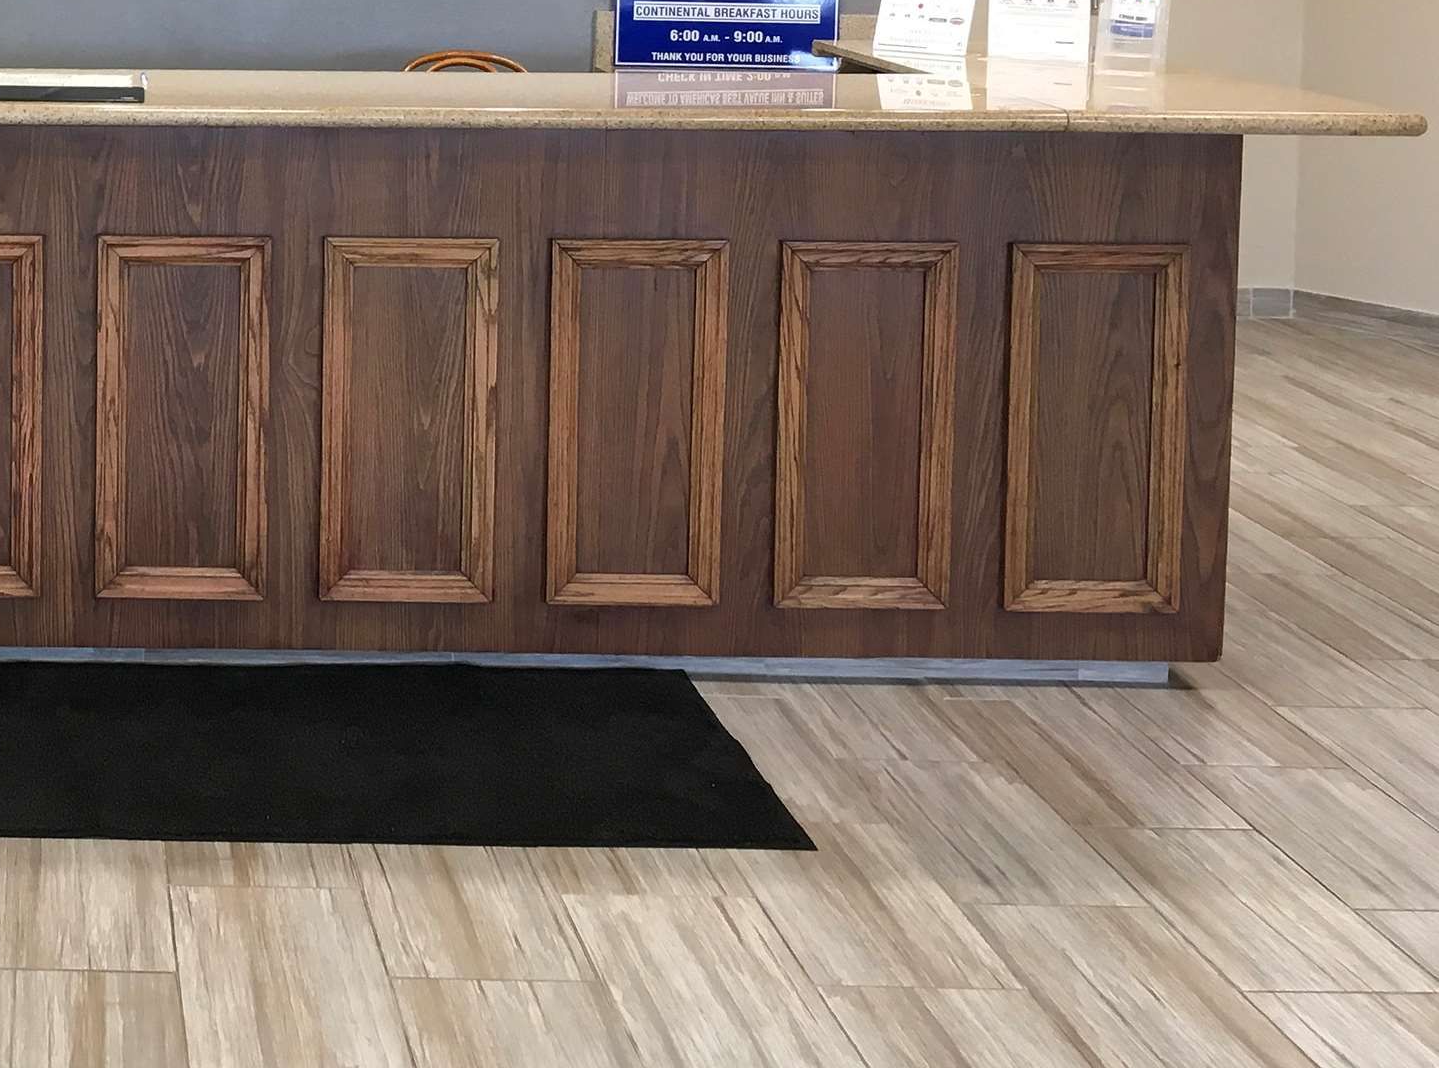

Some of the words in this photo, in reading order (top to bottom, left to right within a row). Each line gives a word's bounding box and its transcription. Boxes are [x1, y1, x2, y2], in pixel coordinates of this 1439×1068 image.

[636, 5, 710, 18] CONTINENTAL
[714, 7, 777, 19] BREAKFAST
[781, 9, 819, 20] HOURS
[670, 29, 700, 42] 6:00
[703, 34, 721, 42] A.M.
[733, 30, 763, 43] 9:00
[765, 35, 783, 43] A.M.
[651, 52, 682, 61] THANK
[684, 52, 703, 61] YOU
[706, 53, 724, 62] FOR
[727, 53, 752, 62] YOUR
